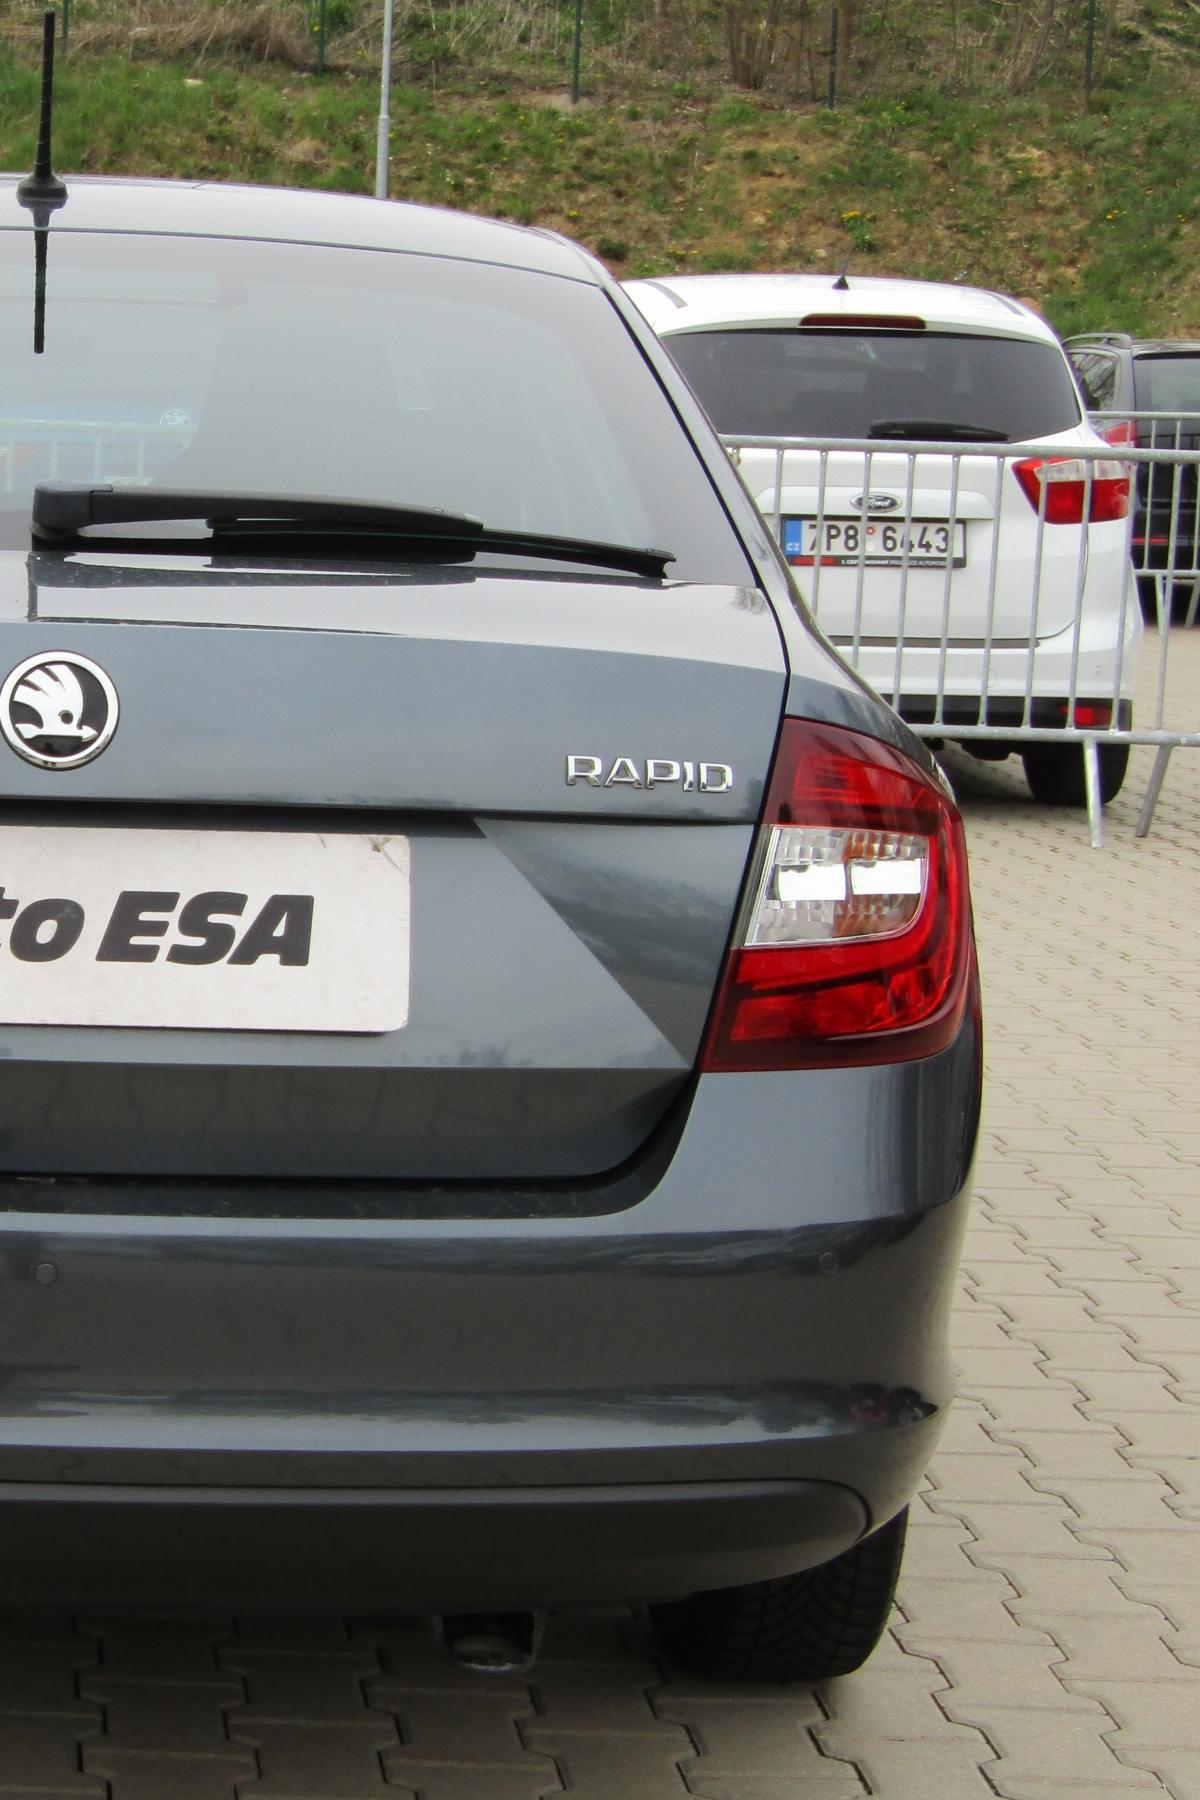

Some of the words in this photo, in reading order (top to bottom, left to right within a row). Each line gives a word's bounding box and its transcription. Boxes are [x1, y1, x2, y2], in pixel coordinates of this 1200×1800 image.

[808, 524, 860, 552] 7P8
[881, 525, 949, 553] 6443
[565, 755, 733, 793] RAPID
[96, 890, 315, 967] ESA
